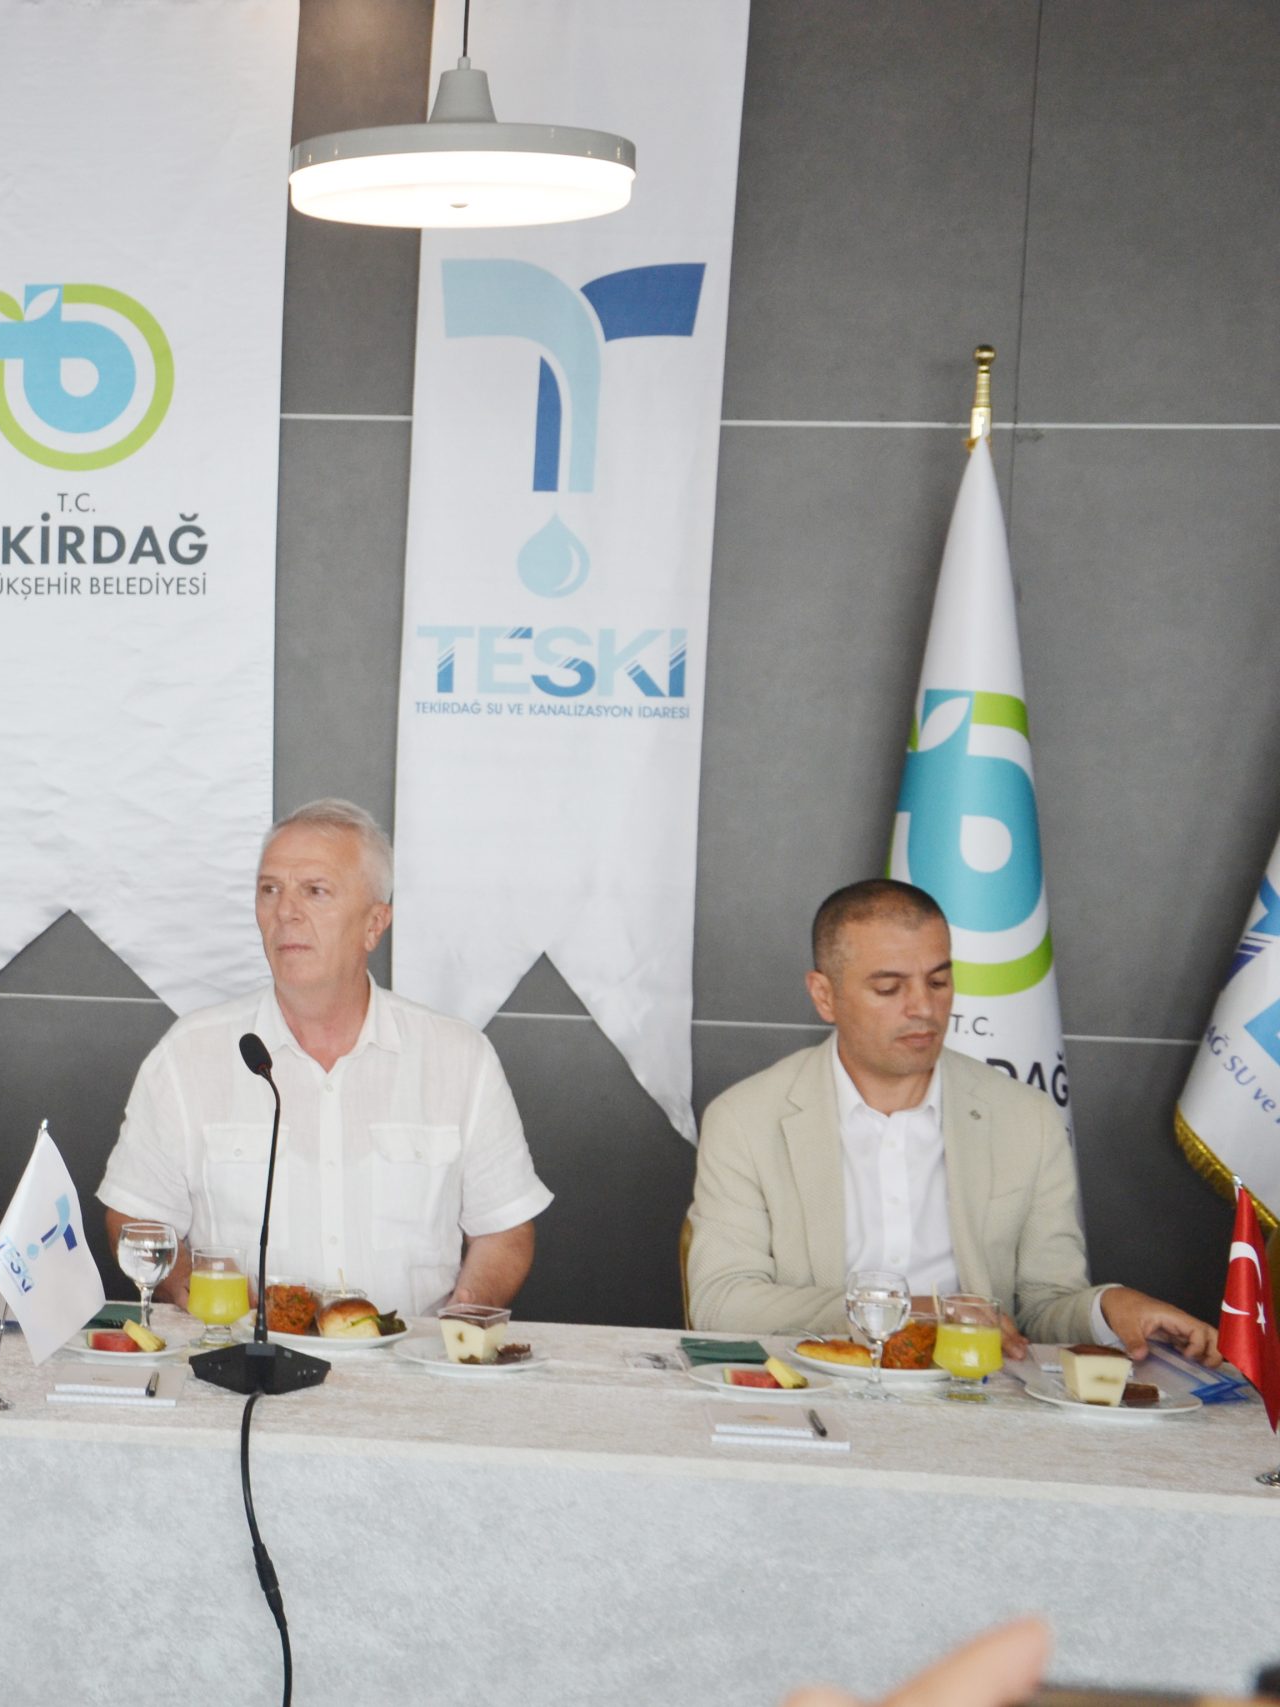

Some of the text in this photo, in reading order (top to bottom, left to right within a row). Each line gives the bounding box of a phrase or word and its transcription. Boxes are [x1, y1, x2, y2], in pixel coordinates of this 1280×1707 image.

[57, 492, 97, 513] T.C.
[90, 571, 207, 596] BELEDİYESİ
[487, 702, 503, 715] SU
[508, 703, 523, 716] VE
[949, 1013, 995, 1037] T.C.
[1222, 1055, 1257, 1086] SU
[1253, 1088, 1277, 1113] ve
